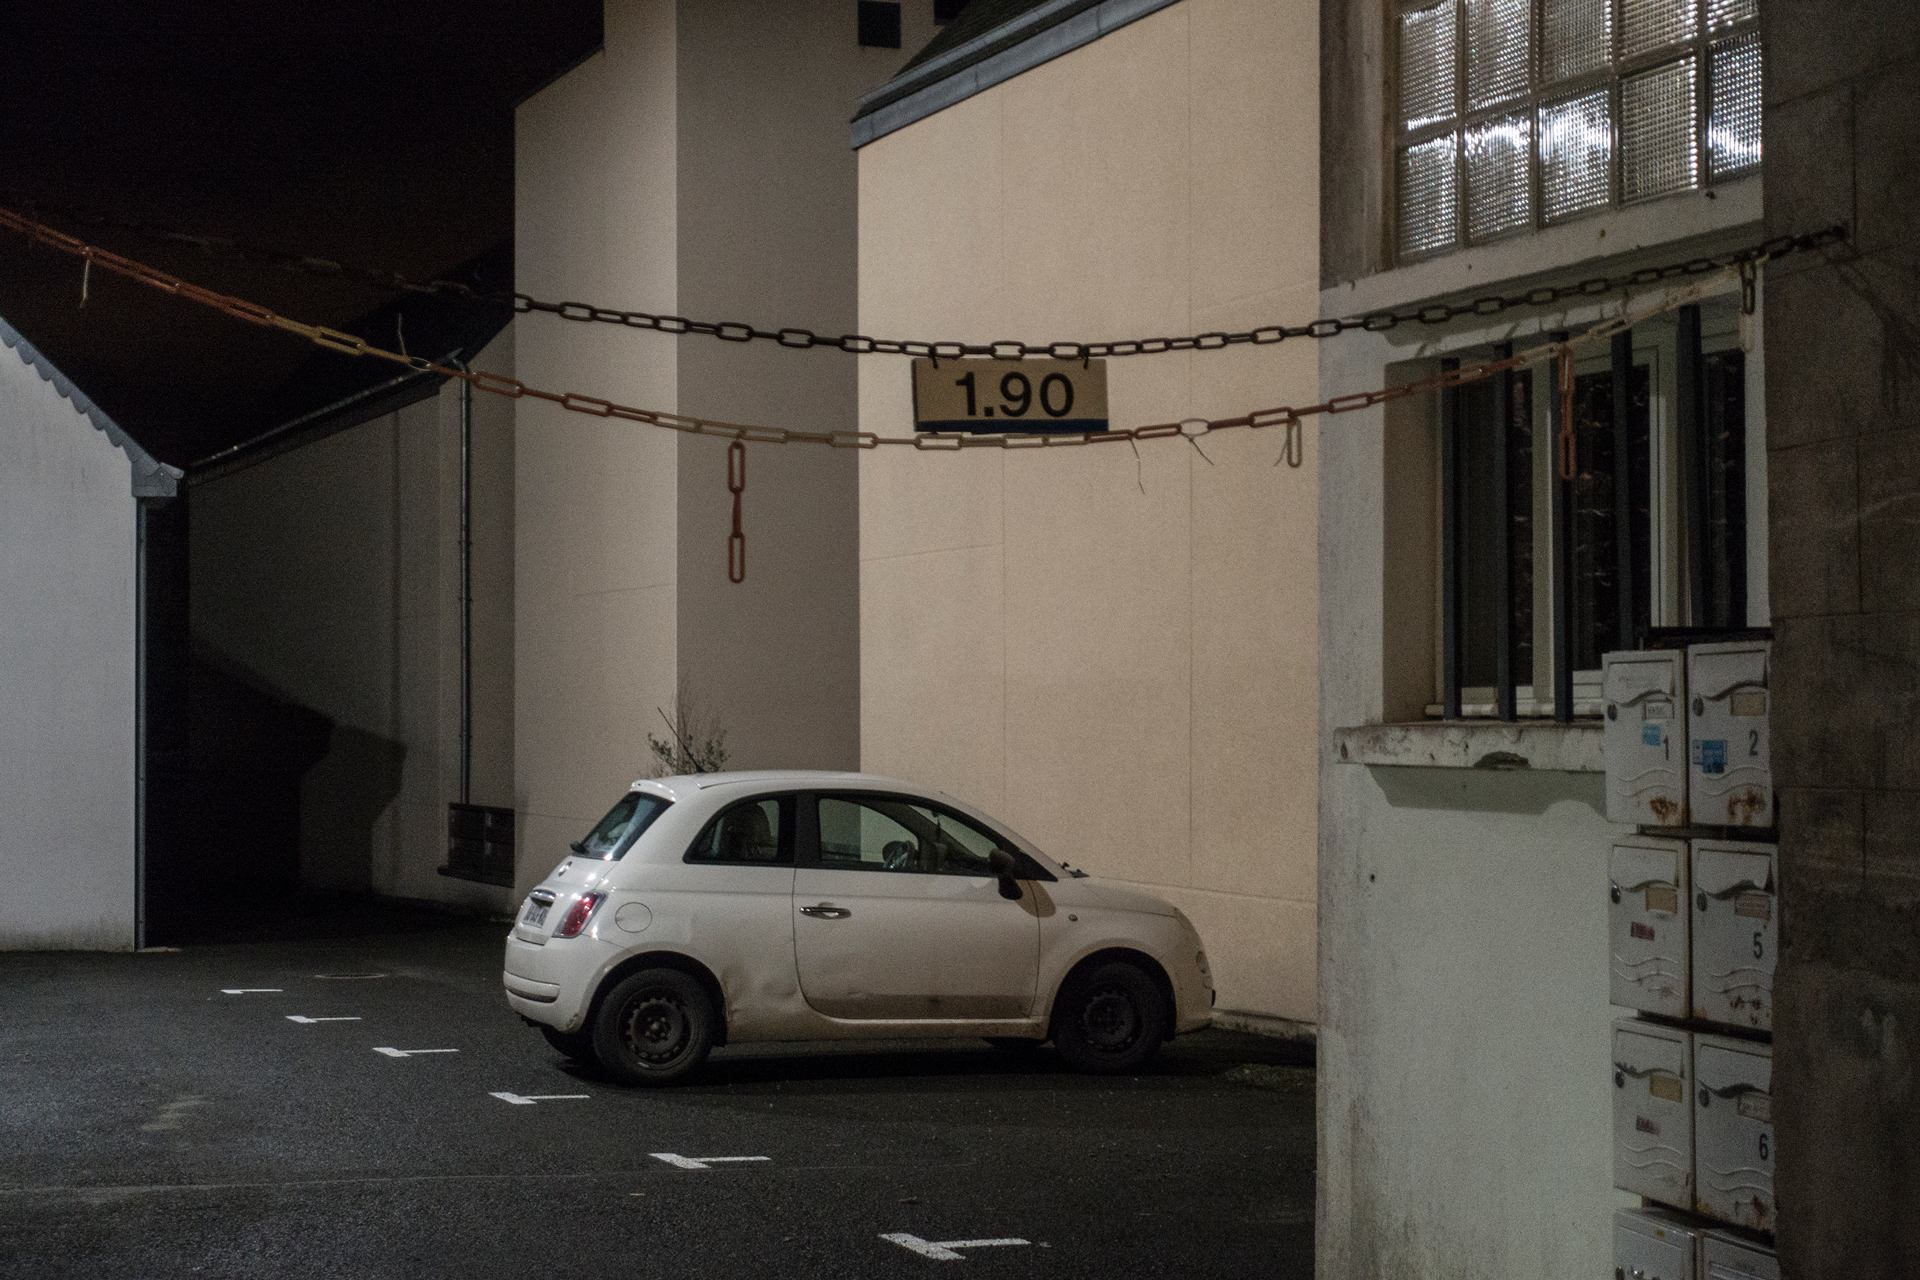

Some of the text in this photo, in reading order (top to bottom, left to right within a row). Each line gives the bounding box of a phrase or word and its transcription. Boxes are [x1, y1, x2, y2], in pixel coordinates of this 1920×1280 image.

[955, 372, 1074, 417] 1.90
[1662, 735, 1669, 760] 1
[1748, 730, 1758, 756] 2
[1753, 932, 1763, 959] 5
[1759, 1134, 1769, 1161] 6
